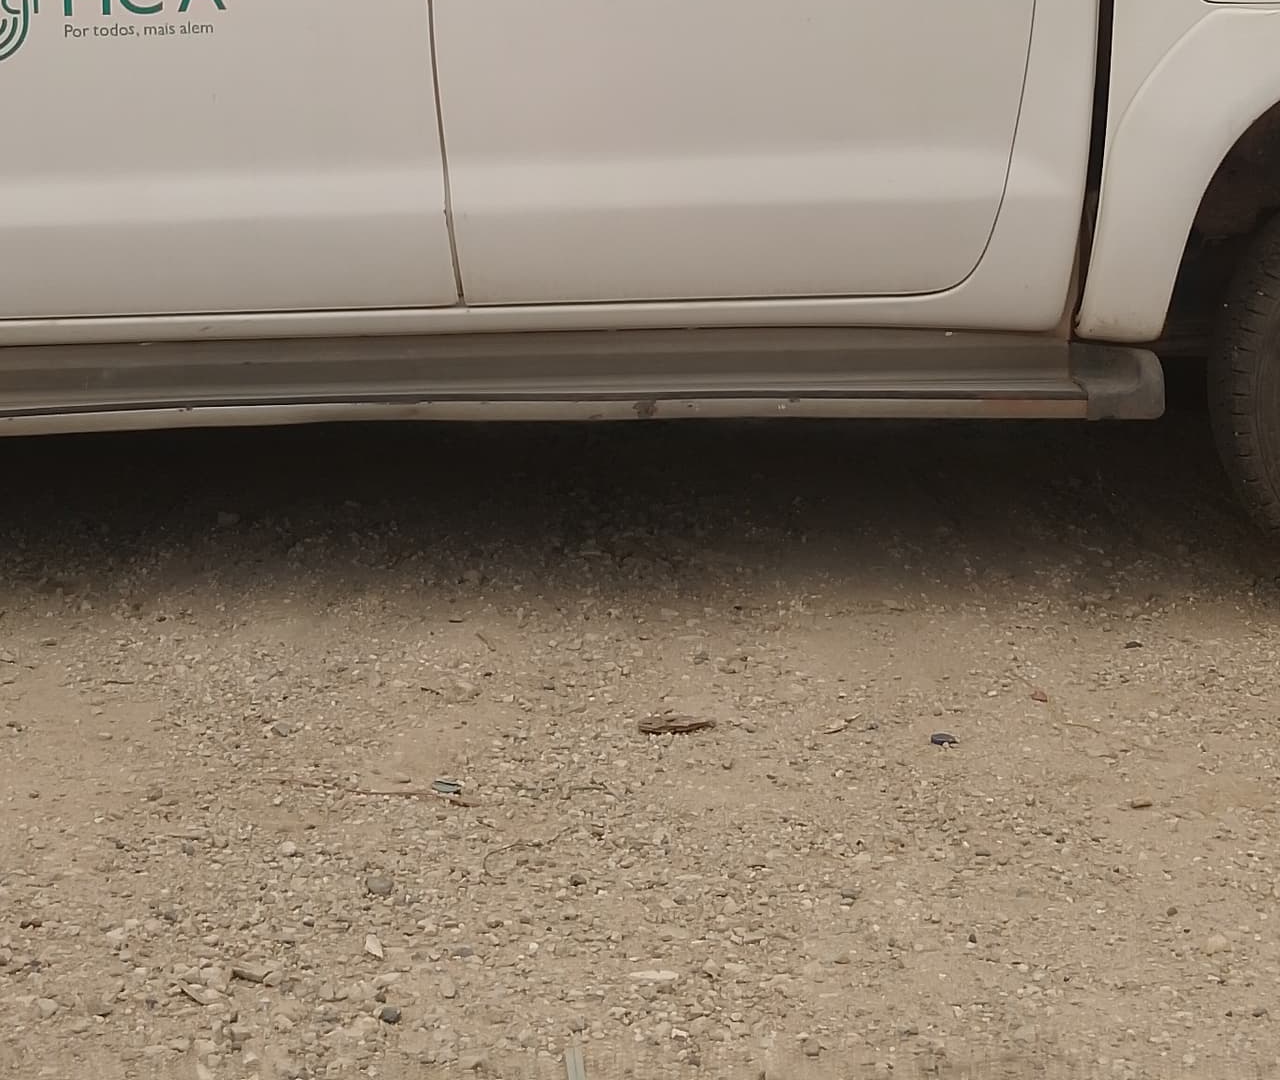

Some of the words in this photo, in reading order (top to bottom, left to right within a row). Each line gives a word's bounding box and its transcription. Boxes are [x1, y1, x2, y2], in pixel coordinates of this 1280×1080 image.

[64, 23, 90, 38] Por
[93, 23, 140, 38] todos,
[143, 23, 176, 36] mais
[179, 20, 214, 35] alem
